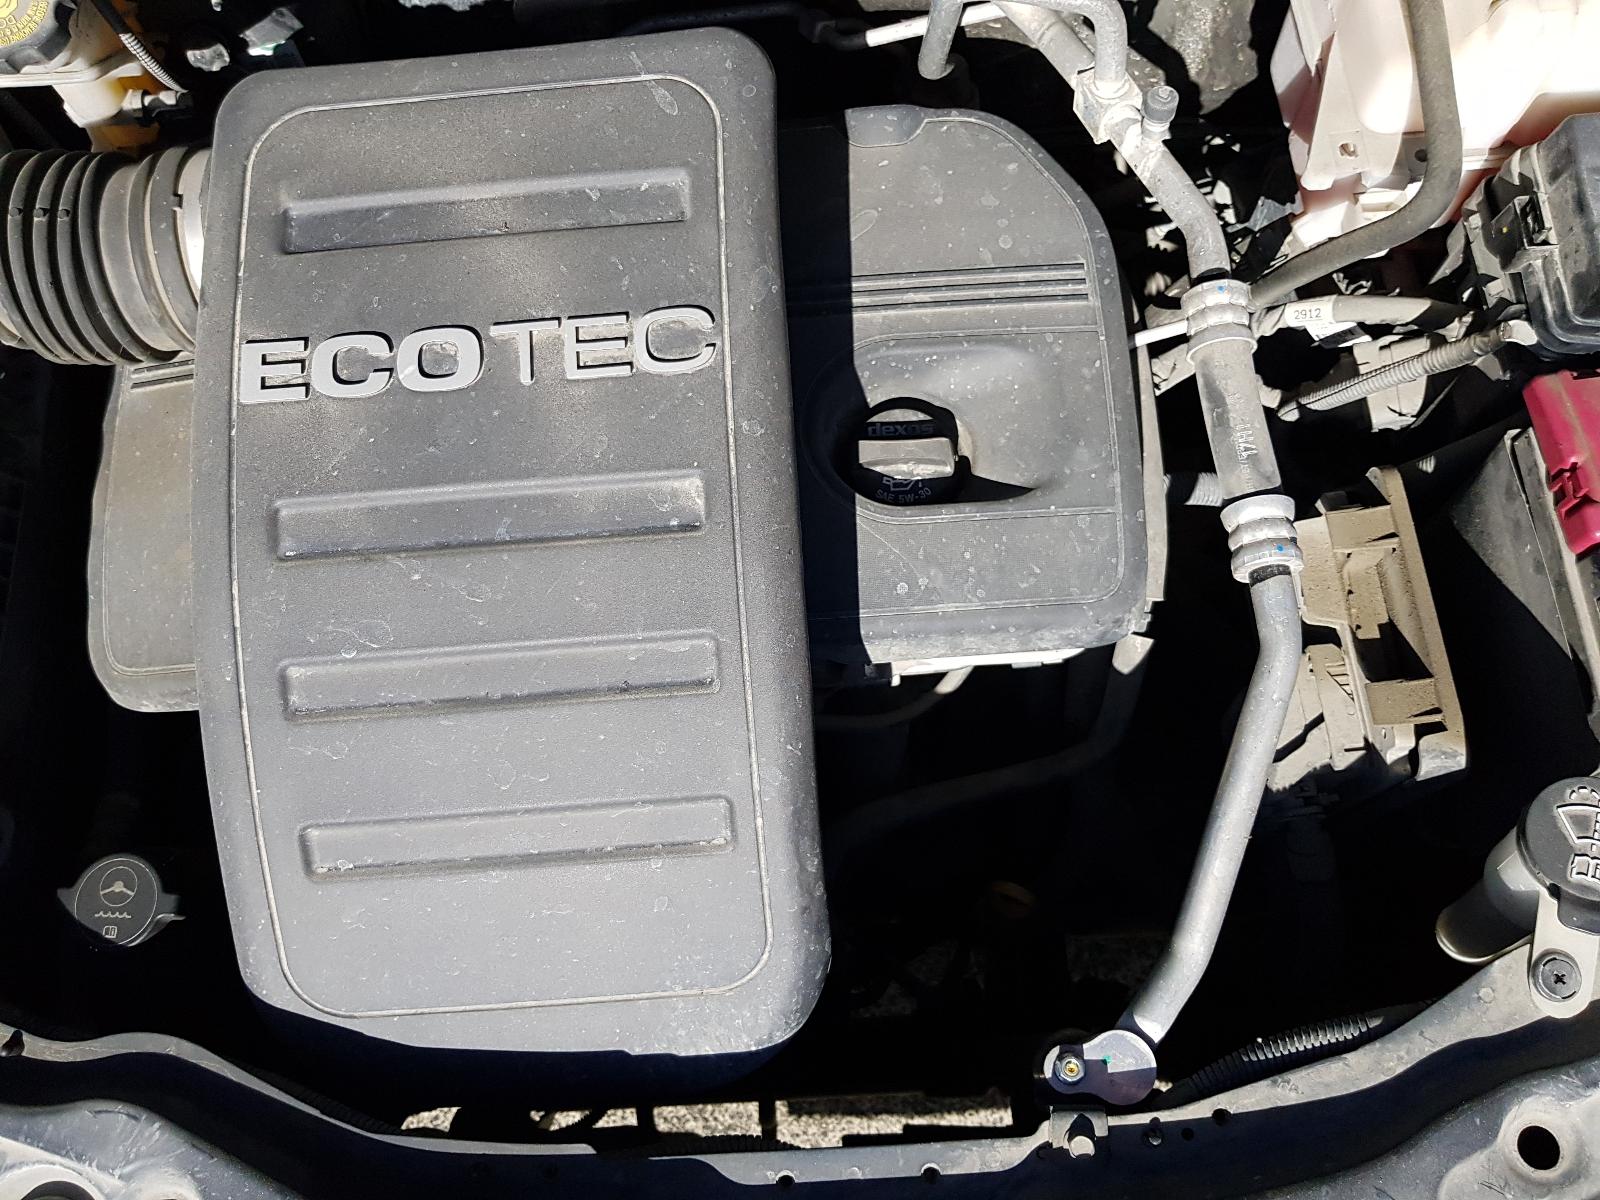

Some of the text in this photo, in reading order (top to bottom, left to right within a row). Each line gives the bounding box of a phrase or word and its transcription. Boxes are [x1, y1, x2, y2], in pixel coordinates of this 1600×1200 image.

[1294, 308, 1322, 320] 2912
[239, 305, 718, 404] ECOTEC
[867, 423, 935, 437] dexos
[876, 487, 932, 503] SAE 5W-30
